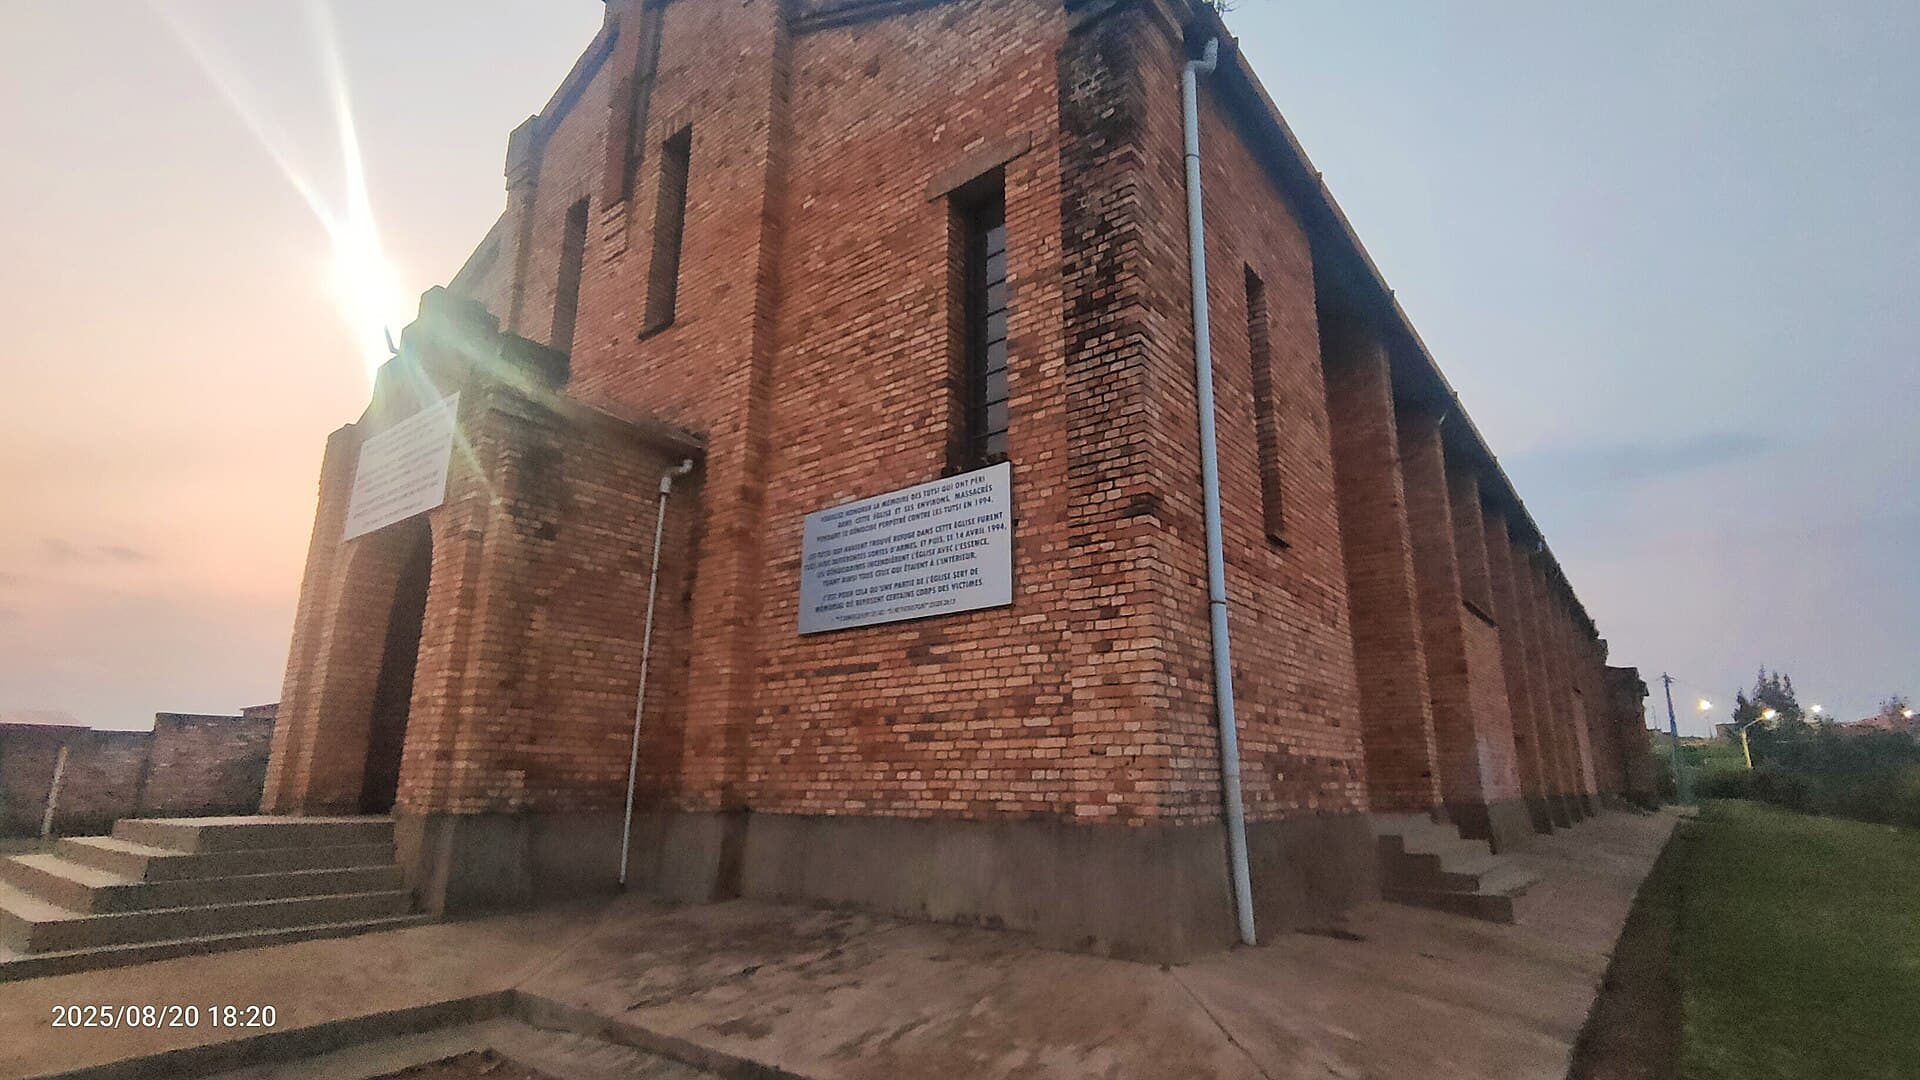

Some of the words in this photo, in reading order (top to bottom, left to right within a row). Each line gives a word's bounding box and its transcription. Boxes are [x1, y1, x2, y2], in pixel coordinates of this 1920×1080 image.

[912, 492, 922, 500] DES
[924, 488, 940, 496] TUTSI
[942, 482, 954, 492] QUI
[955, 480, 968, 489] ONT
[970, 476, 986, 486] PÉRI
[856, 515, 870, 524] CETTE
[904, 504, 914, 512] SES
[954, 484, 992, 499] MASSACRÉS
[908, 511, 930, 522] CONTRE
[932, 508, 942, 516] LES
[944, 503, 962, 512] TUTSI
[964, 501, 972, 509] EN
[917, 528, 933, 536] DANS
[936, 524, 952, 532] CETTE
[954, 518, 975, 528] ÉGLISE
[977, 512, 1002, 524] FURENT
[956, 531, 964, 539] 14
[966, 528, 984, 538] AVRIL
[912, 548, 935, 560] L'ÉGLISE
[937, 545, 953, 554] AVEC
[904, 560, 928, 572] ÉTAIENT
[894, 579, 914, 589] PARTIE
[953, 570, 968, 579] SERT
[970, 568, 978, 576] DE
[916, 586, 936, 596] CORPS
[938, 584, 950, 592] DES
